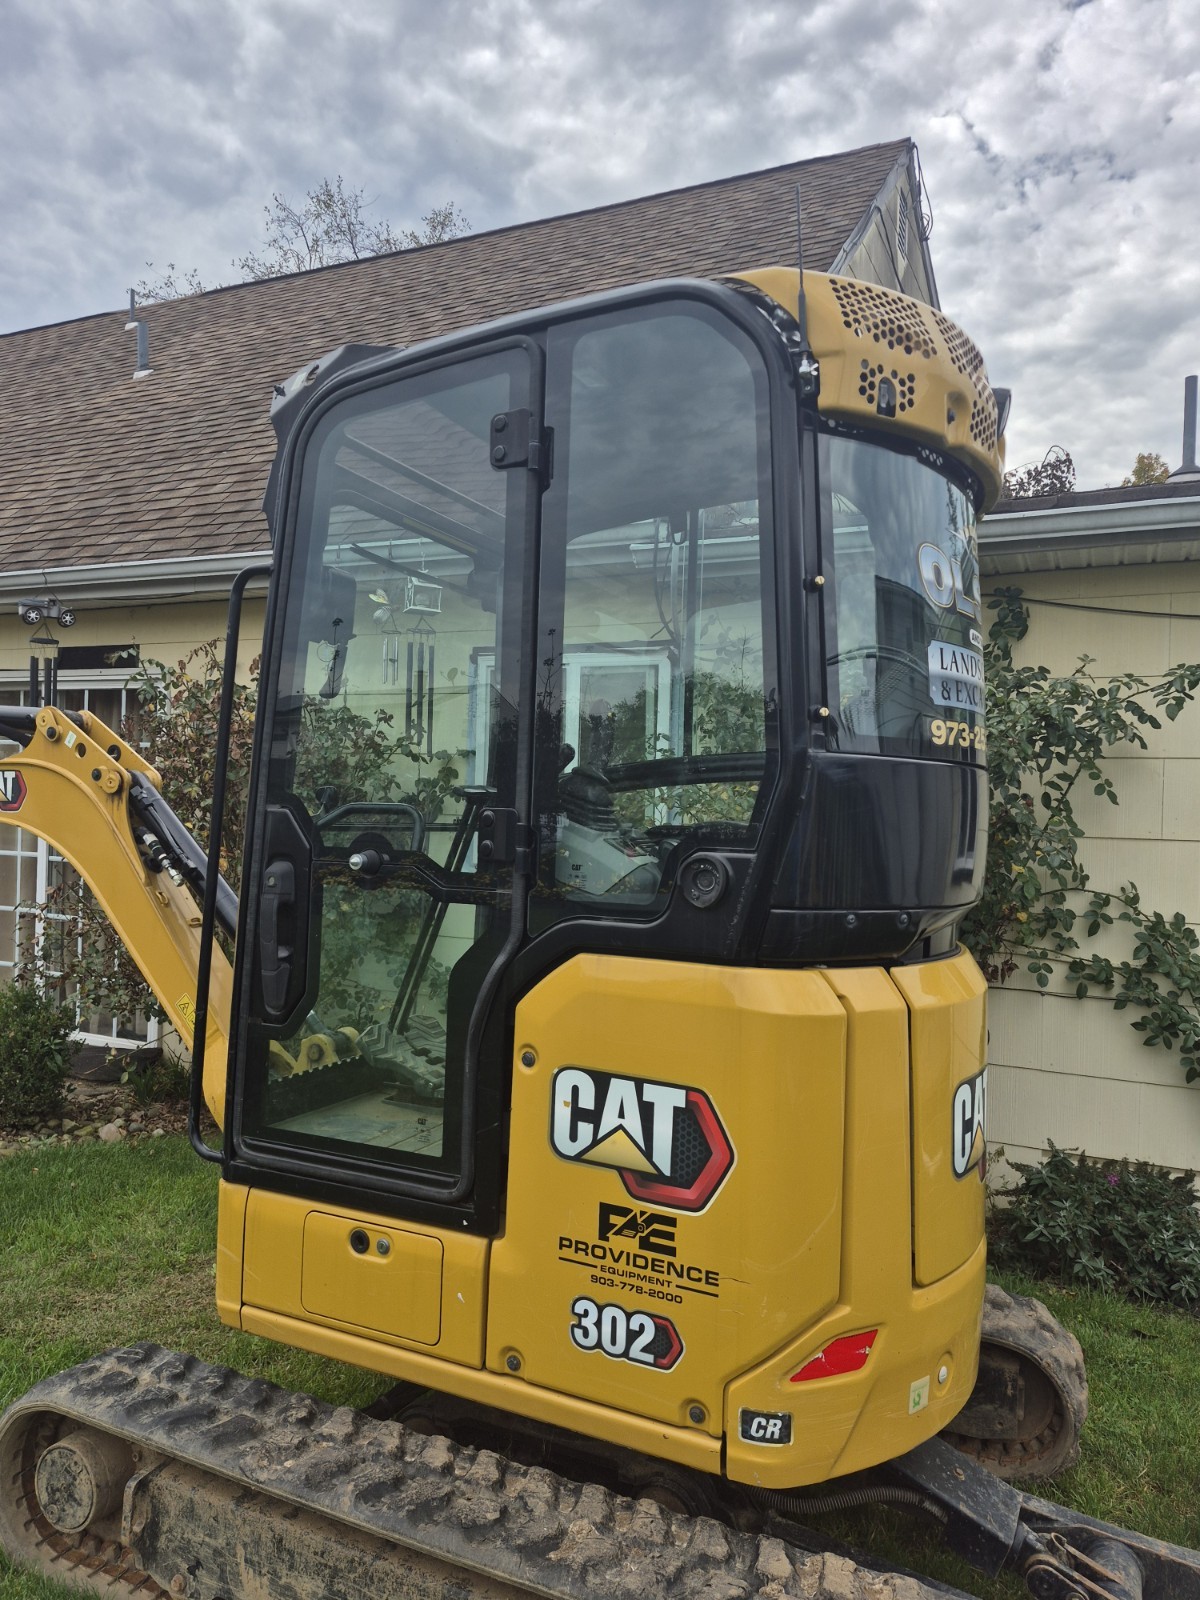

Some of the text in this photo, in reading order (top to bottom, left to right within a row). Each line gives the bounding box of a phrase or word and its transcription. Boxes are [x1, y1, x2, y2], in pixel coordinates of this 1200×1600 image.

[941, 680, 951, 701] &
[554, 1069, 687, 1177] CAT
[559, 1236, 719, 1287] PROVIDENCE
[600, 1264, 672, 1289] EQUIPMENT
[590, 1274, 683, 1304] 903-778-2000
[573, 1299, 656, 1364] 302
[750, 1417, 782, 1439] CR
